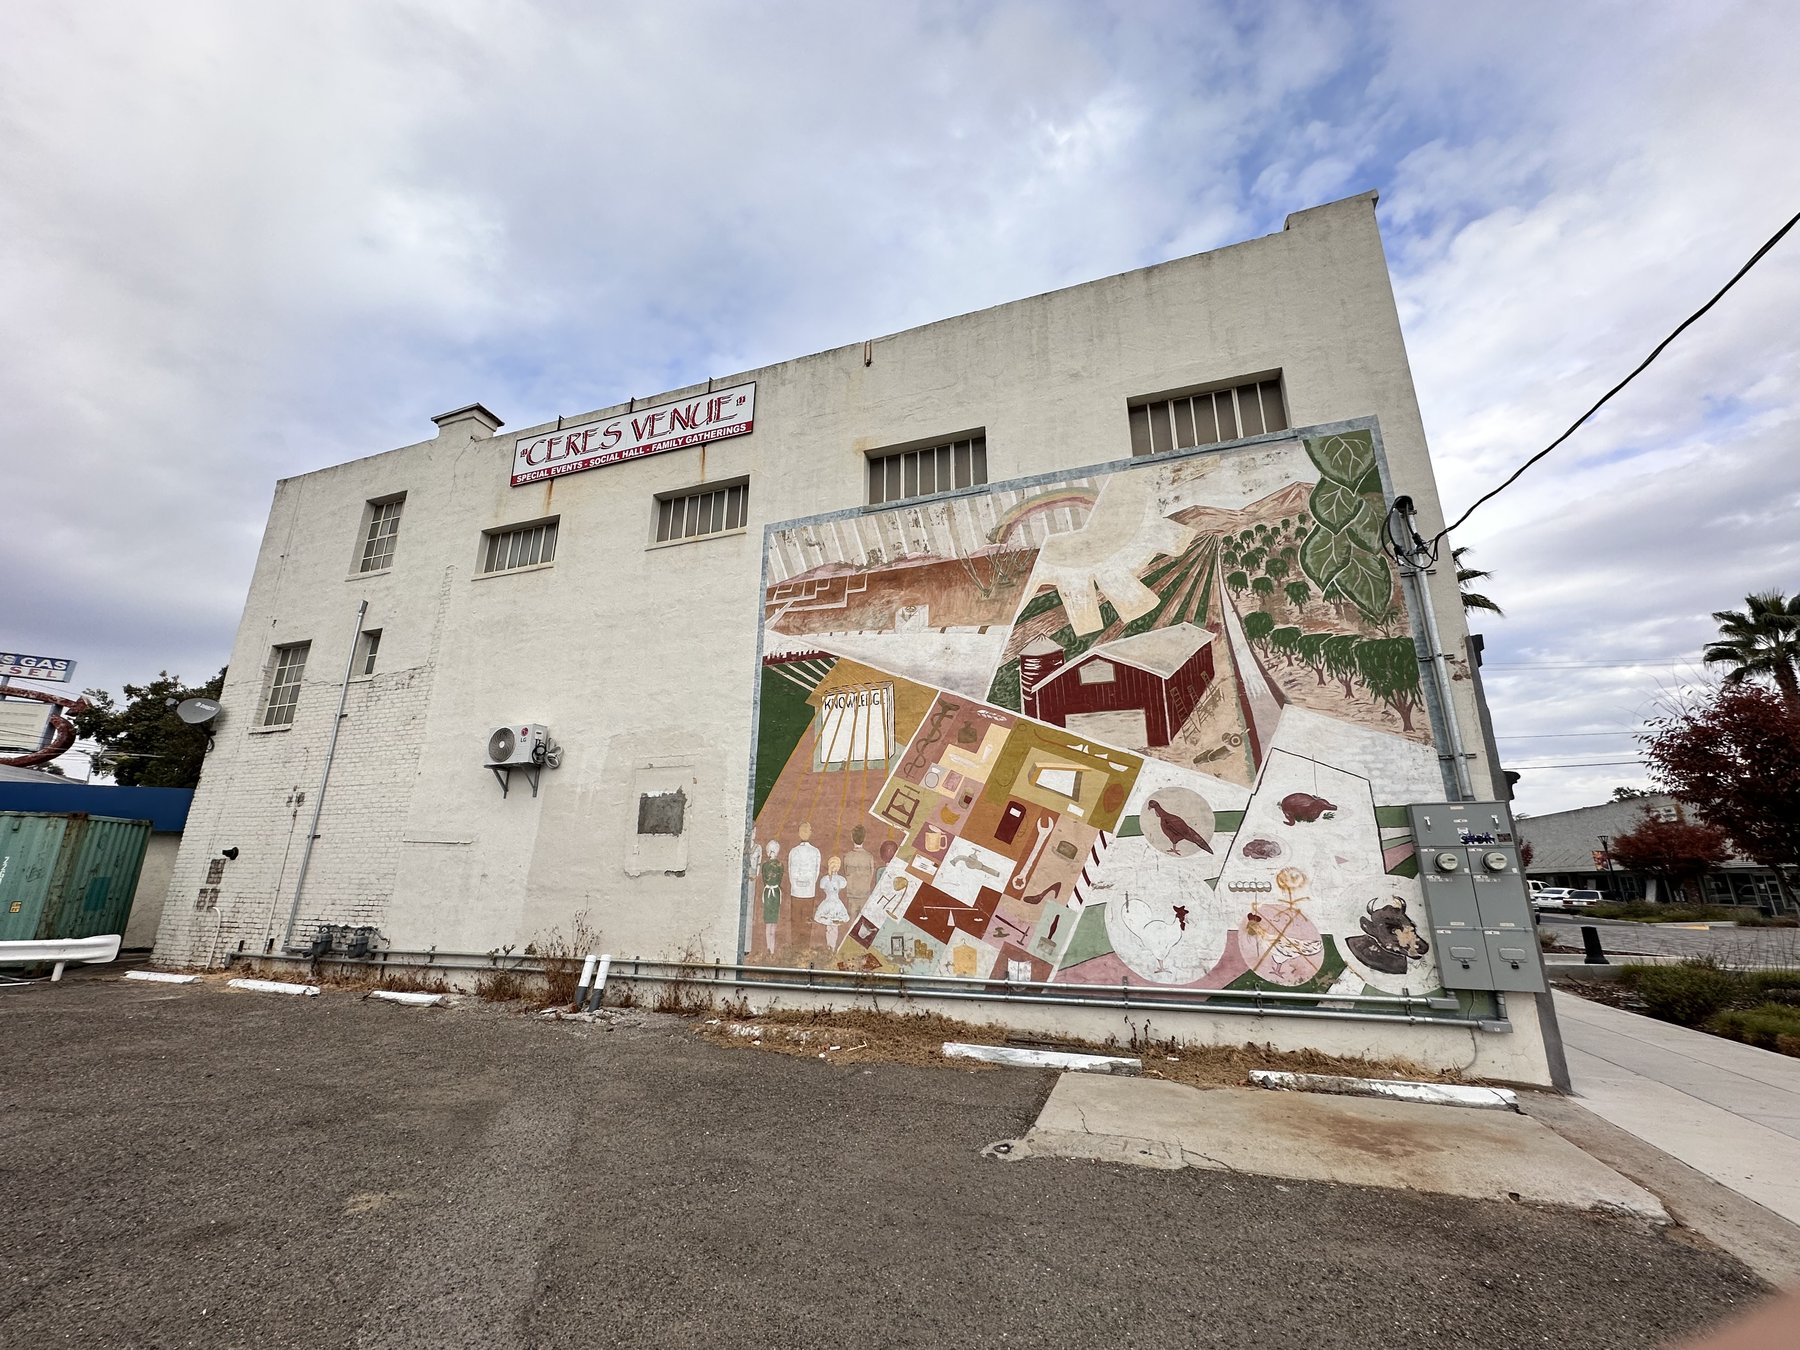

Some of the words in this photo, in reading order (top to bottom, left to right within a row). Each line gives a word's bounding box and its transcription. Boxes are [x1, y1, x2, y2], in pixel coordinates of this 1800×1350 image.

[516, 469, 549, 483] SPECIAL
[551, 460, 583, 475] EVENTS
[589, 453, 620, 467] SOCIAL
[622, 446, 645, 459] HALL
[651, 438, 684, 451] FAMILY
[685, 423, 747, 444] GATHERINGS
[20, 657, 68, 670] GAS
[824, 691, 886, 710] KNOWLEDG
